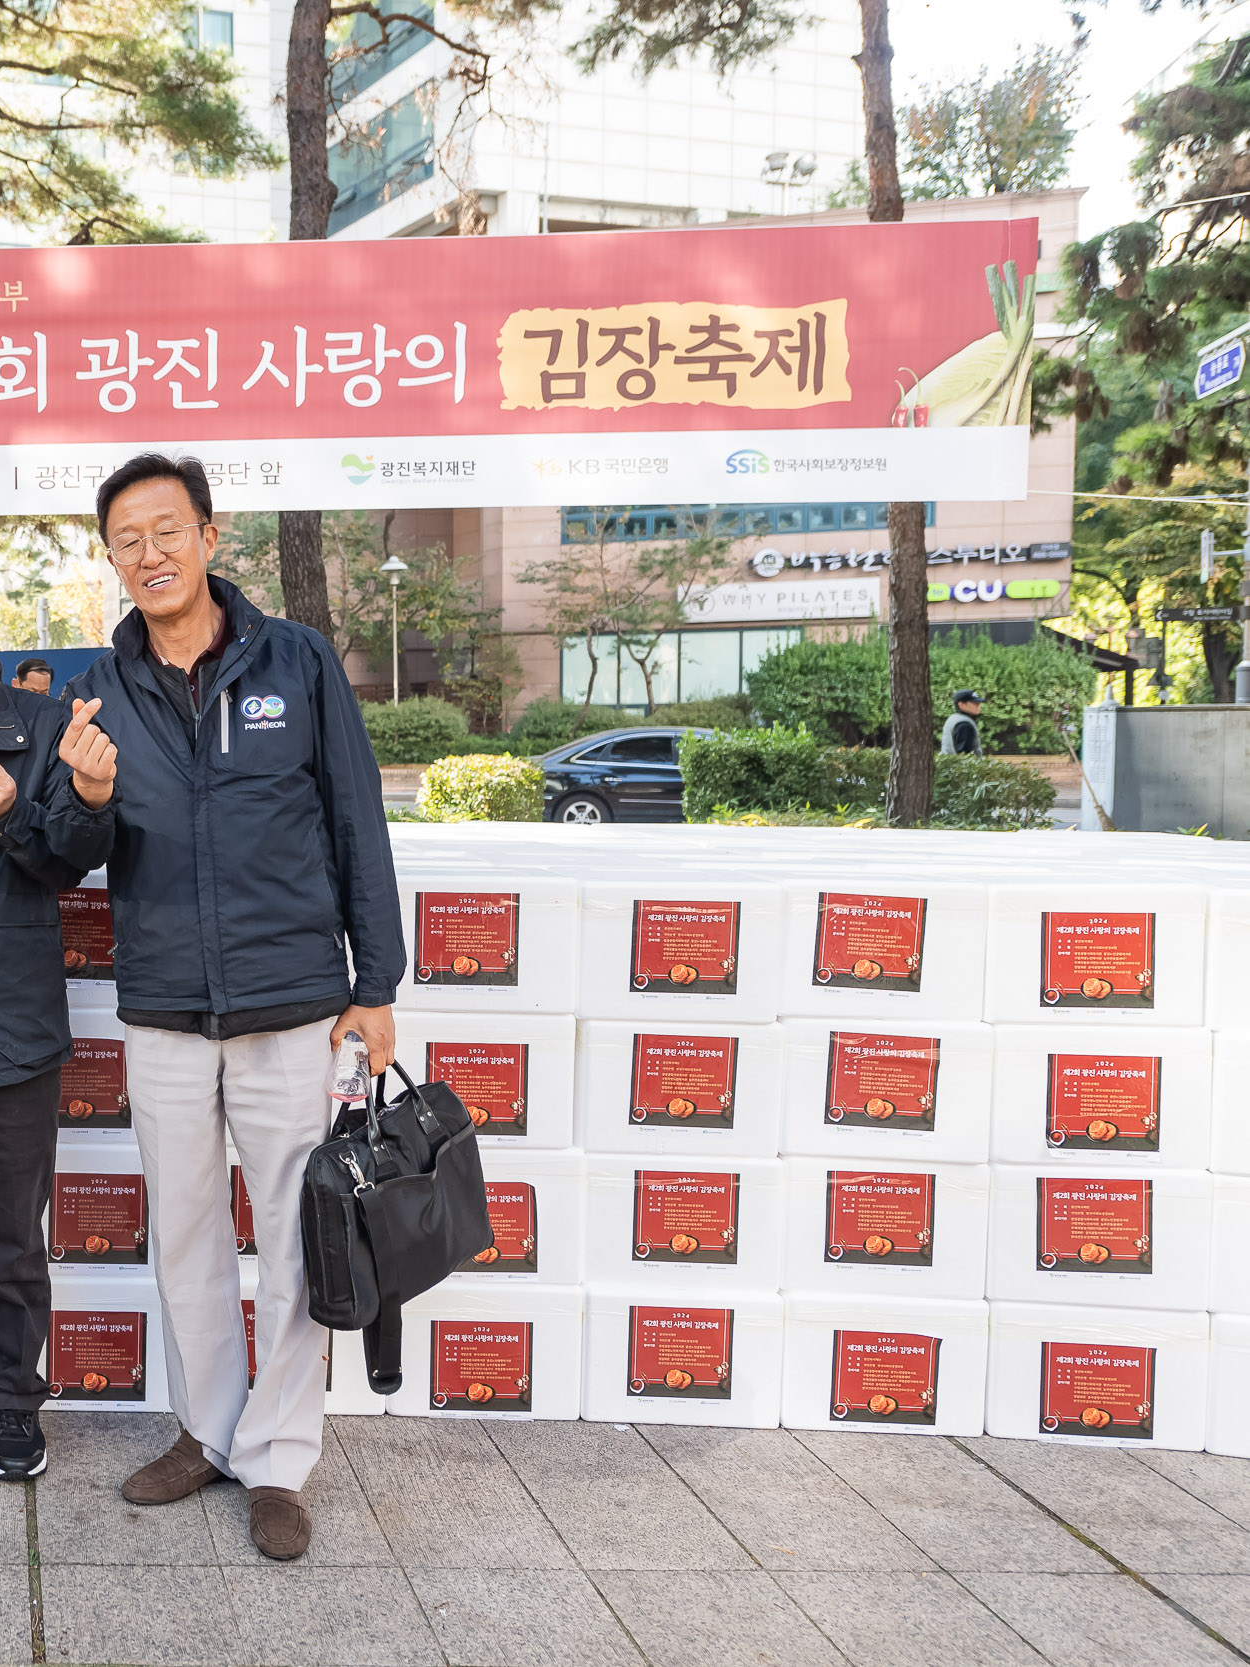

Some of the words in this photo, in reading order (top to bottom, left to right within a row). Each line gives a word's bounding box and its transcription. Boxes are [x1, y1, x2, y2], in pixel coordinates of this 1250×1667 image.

[75, 326, 220, 413] 광진
[242, 321, 466, 408] 사랑의
[523, 311, 827, 404] 김장축제
[380, 460, 477, 478] 광진복지재단
[569, 458, 600, 475] KB
[604, 457, 669, 475] 국민은행
[774, 457, 887, 473] 한국사회보장정보원
[35, 465, 116, 489] 광진구
[260, 461, 283, 485] 앞
[927, 542, 1027, 566] 스투디오
[954, 579, 1003, 603] CU
[1056, 926, 1074, 934] 제2회
[1090, 926, 1111, 934] 사랑의
[1112, 926, 1139, 934] 김장축제
[646, 1047, 662, 1055] 제2회
[677, 1048, 697, 1056] 사랑의
[697, 1049, 723, 1058] 김장축제
[1062, 1068, 1080, 1076] 제2회
[1096, 1069, 1117, 1077] 사랑의
[1118, 1069, 1146, 1078] 김장축제
[647, 1184, 664, 1192] 제2회
[679, 1185, 698, 1193] 사랑의
[699, 1185, 725, 1194] 김장축제
[1052, 1191, 1070, 1199] 제2회
[1086, 1192, 1107, 1200] 사랑의
[1109, 1192, 1136, 1201] 김장축제
[642, 1319, 658, 1327] 제2회
[673, 1320, 692, 1328] 사랑의
[694, 1321, 719, 1329] 김장축제
[474, 1334, 493, 1342] 사랑의
[494, 1334, 519, 1342] 김장축제
[846, 1343, 863, 1352] 제2회
[878, 1345, 898, 1353] 사랑의
[899, 1346, 924, 1355] 김장축제
[1055, 1355, 1073, 1364] 제2회
[1089, 1357, 1110, 1366] 사랑의
[1112, 1358, 1139, 1367] 김장축제
